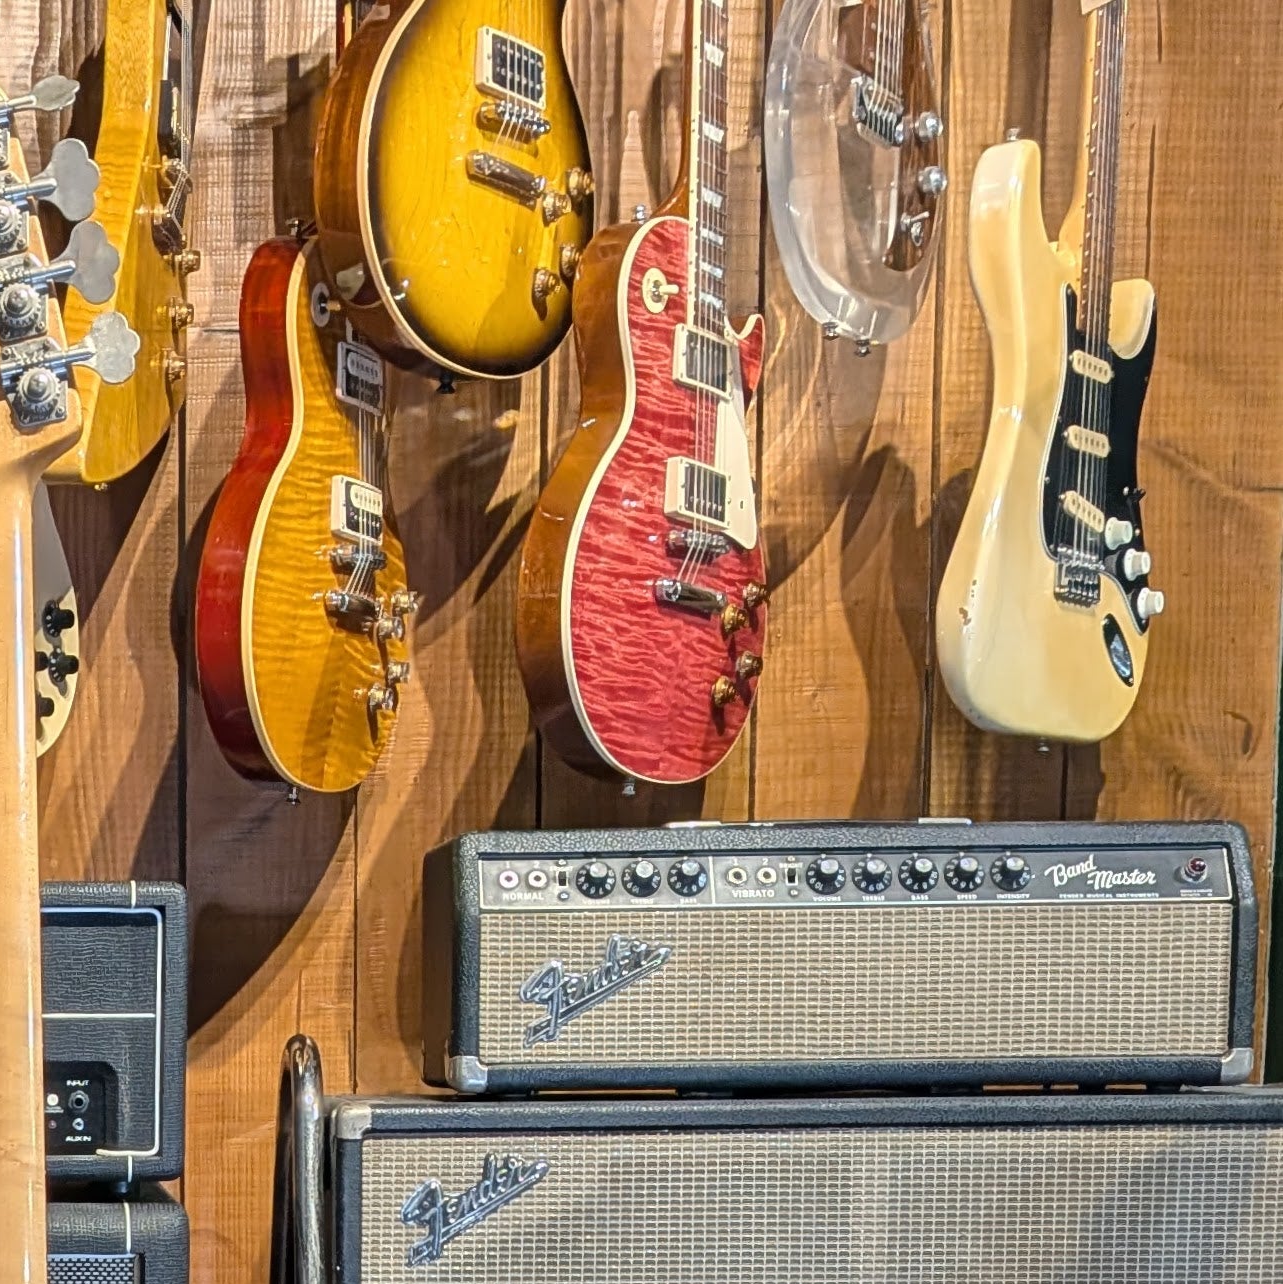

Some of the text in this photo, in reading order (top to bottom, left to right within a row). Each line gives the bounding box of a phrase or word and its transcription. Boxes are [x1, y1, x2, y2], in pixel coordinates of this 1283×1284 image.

[1044, 853, 1098, 888] Band
[502, 891, 545, 901] NORMAL
[731, 889, 775, 898] VIBRATO
[519, 933, 673, 1049] Fender
[66, 1079, 90, 1087] INPUT
[400, 1151, 551, 1268] Fender
